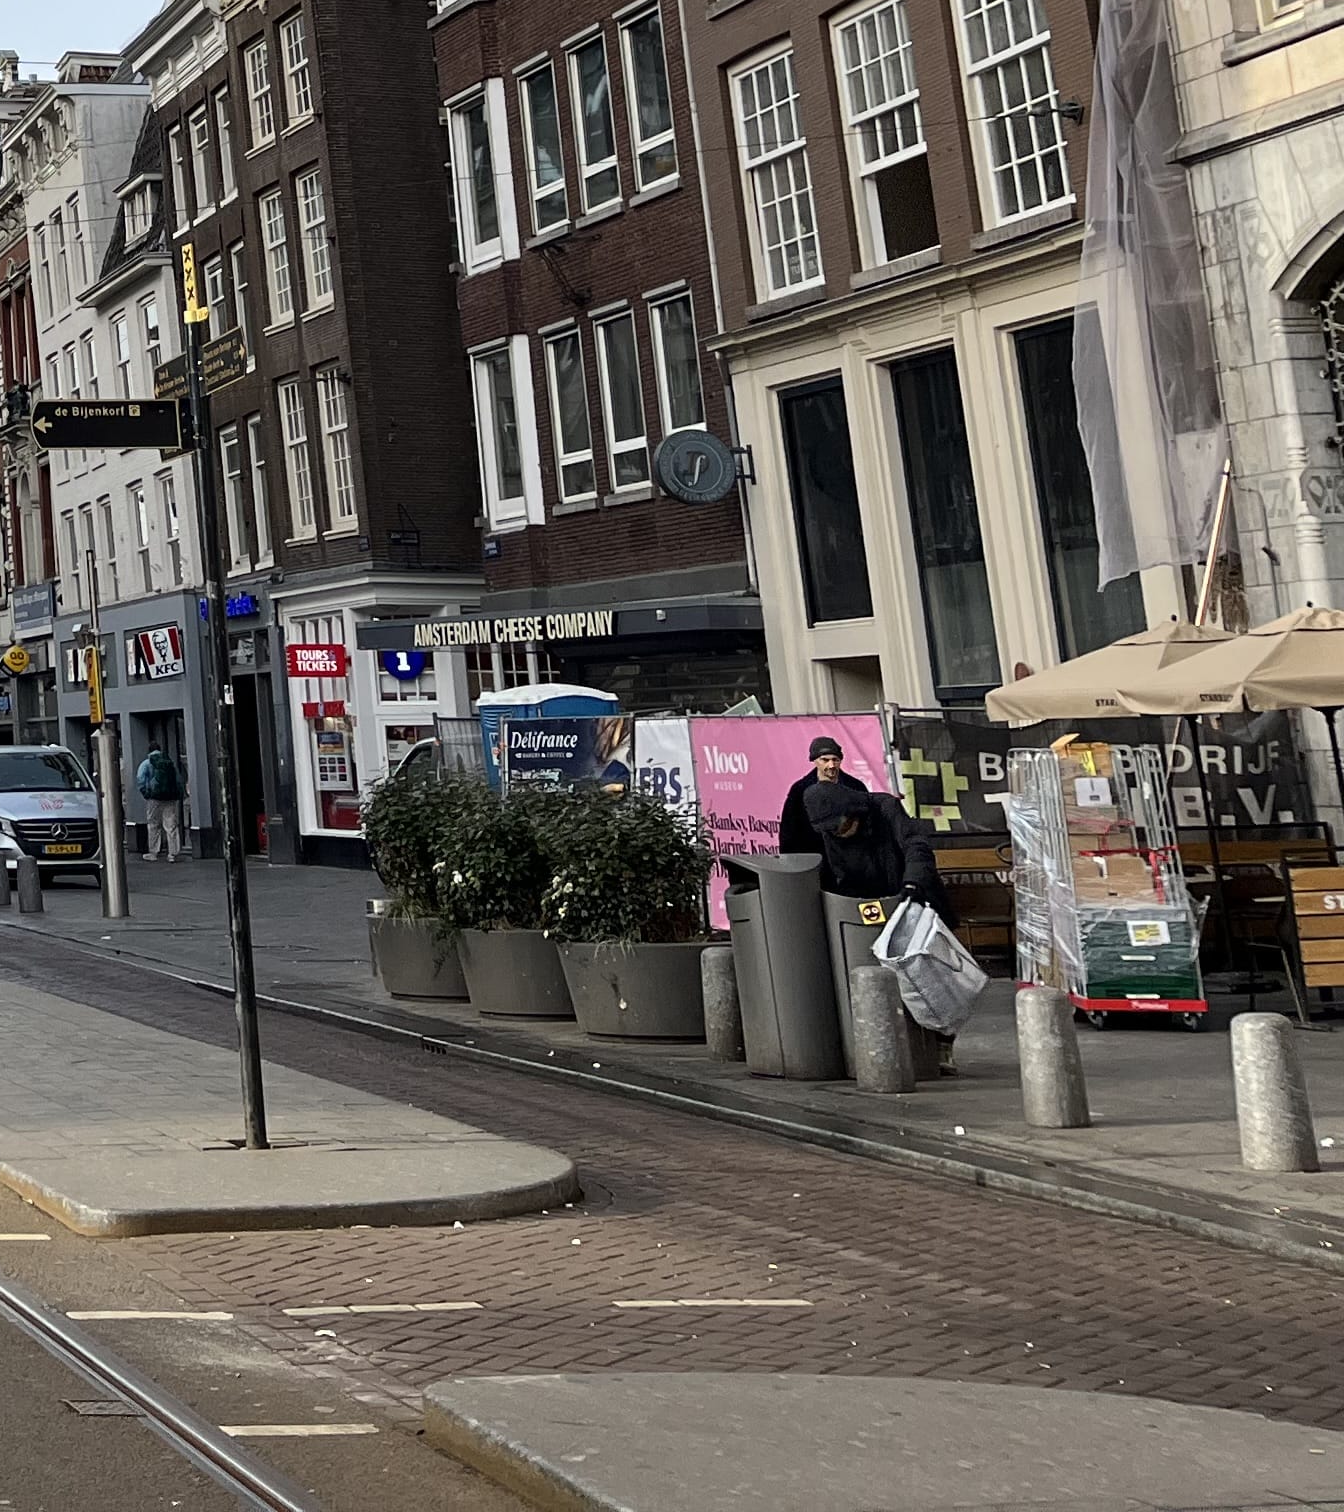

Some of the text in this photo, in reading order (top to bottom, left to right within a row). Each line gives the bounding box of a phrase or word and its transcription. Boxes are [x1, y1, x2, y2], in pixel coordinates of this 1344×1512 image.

[54, 405, 68, 417] de
[72, 405, 125, 419] Bijenkorf
[414, 610, 614, 648] AMSTERDAM CHEESE COMPANY
[295, 649, 329, 662] TOURS
[396, 652, 411, 672] 1
[155, 662, 180, 676] KFC
[297, 660, 338, 672] TICKETS
[510, 731, 578, 752] Délifrance
[702, 745, 749, 775] Moco
